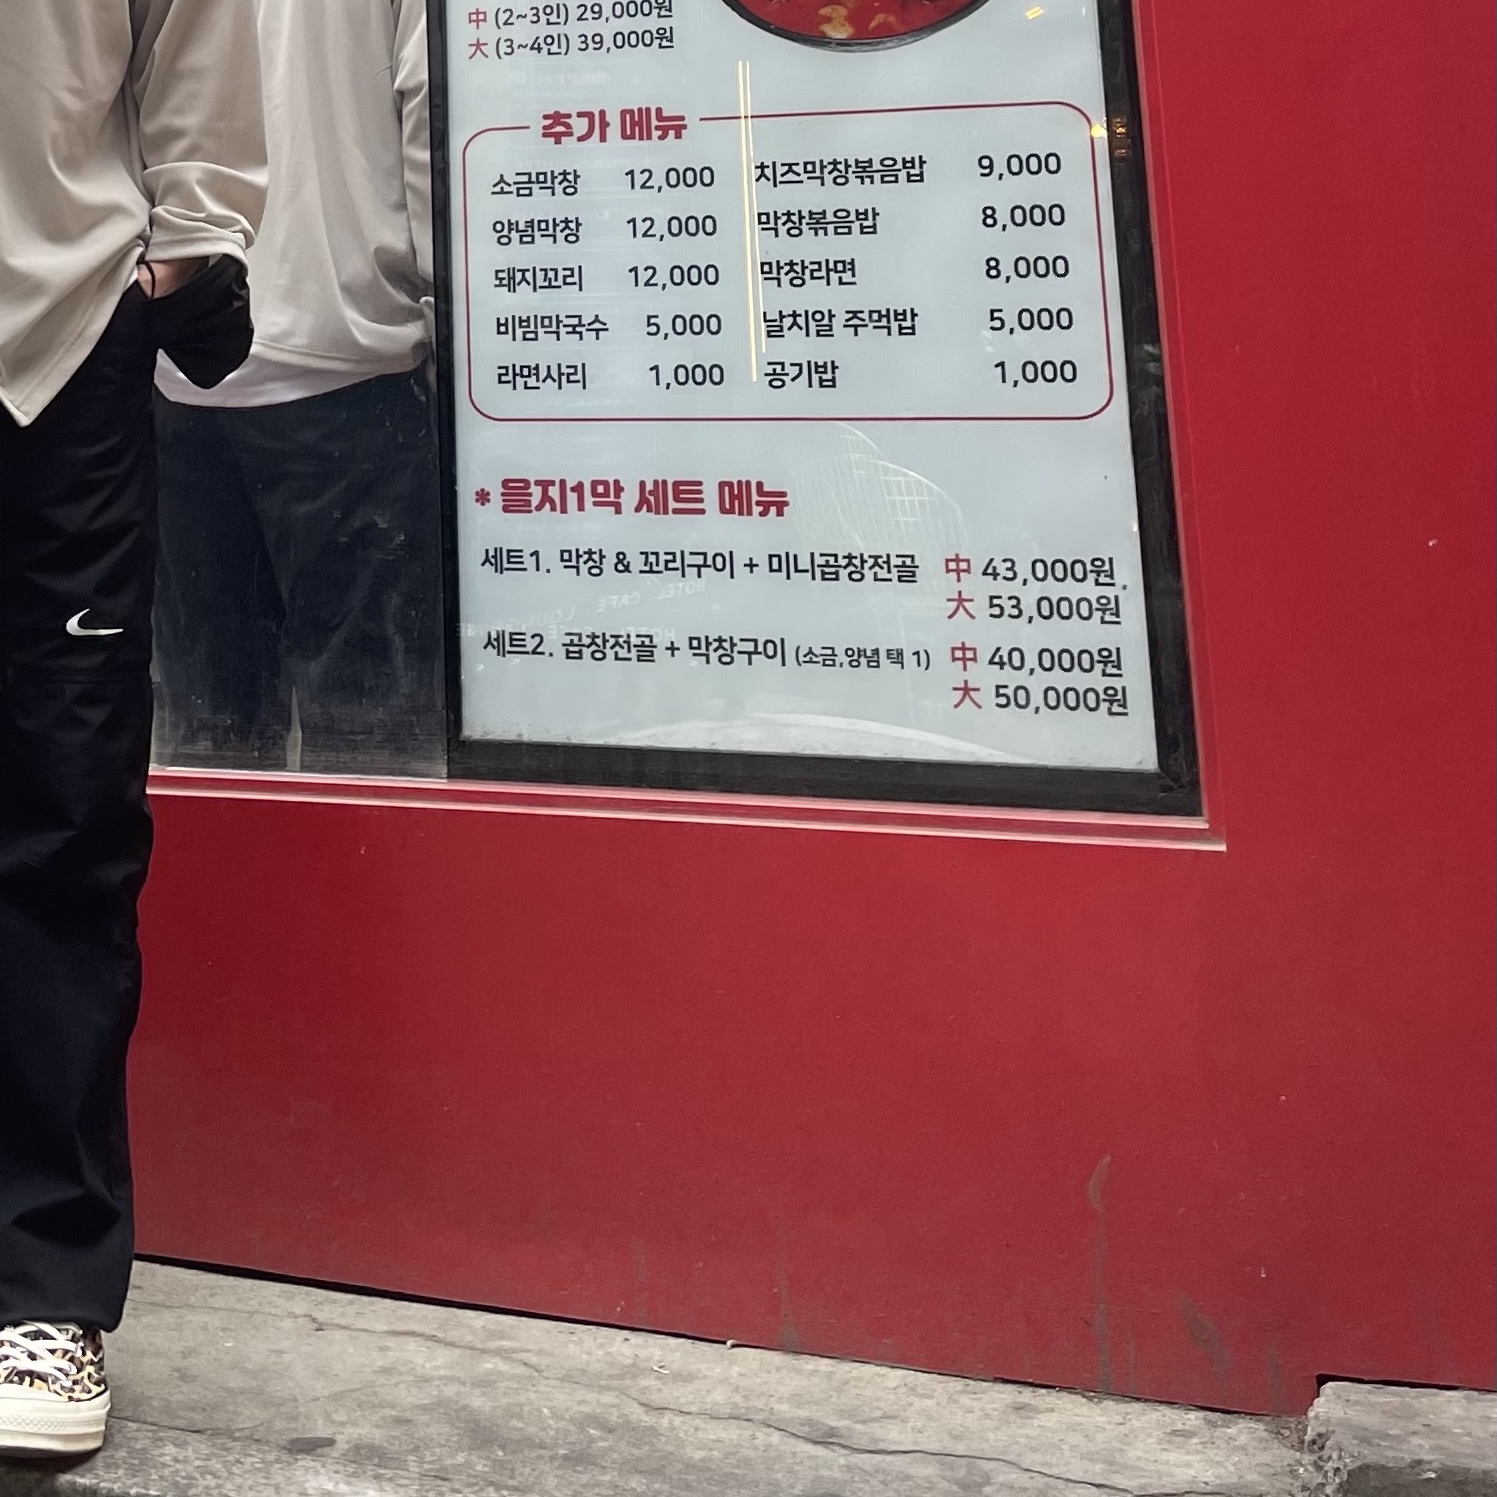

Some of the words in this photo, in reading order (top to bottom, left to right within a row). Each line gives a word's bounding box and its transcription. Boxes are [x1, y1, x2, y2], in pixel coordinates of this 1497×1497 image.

[469, 8, 487, 29] 中
[469, 38, 488, 59] 大
[578, 26, 674, 53] 39,000원
[542, 109, 610, 145] 추가
[620, 107, 687, 141] 메뉴
[491, 169, 580, 197] 소금막창
[625, 167, 714, 193] 12,000
[755, 155, 926, 188] 치즈막창볶음밥
[978, 153, 1061, 180] 9,000
[493, 217, 582, 246] 양념막창
[627, 215, 717, 241] 12,000
[758, 207, 879, 238] 막창볶음밥
[982, 204, 1065, 231] 8,000
[494, 265, 582, 293] 돼지꼬리
[629, 264, 719, 291] 12,000
[760, 258, 857, 288] 막창라면
[986, 256, 1069, 283] 8,000
[497, 314, 609, 341] 비빔막국수
[647, 314, 721, 340] 5,000
[763, 309, 836, 338] 날치알
[843, 308, 918, 336] 주먹밥
[990, 308, 1073, 335] 5,000
[497, 363, 586, 390] 라면사리
[649, 364, 724, 390] 1,000
[764, 360, 839, 389] 공기밥
[994, 360, 1077, 387] 1,000
[501, 479, 624, 517] 을지1막
[634, 478, 706, 517] 세트
[718, 478, 789, 517] 메뉴
[481, 547, 550, 574] 세트1.
[560, 548, 606, 577] 막창
[614, 552, 632, 573] &
[639, 550, 734, 579] 꼬리구이
[744, 557, 759, 573] +
[768, 552, 919, 583] 미니곱창전골
[945, 554, 971, 582] 中
[982, 557, 1116, 586] 43,000원
[947, 591, 975, 619] 大
[989, 595, 1121, 625] 53,000원
[483, 630, 553, 657] 세트2.
[562, 632, 657, 662] 곱창전골
[665, 641, 680, 657] +
[689, 635, 786, 666] 막창구이
[951, 642, 977, 671] 中
[988, 647, 1123, 677] 40,000원
[952, 680, 982, 709] 大
[995, 685, 1128, 716] 50,000원
